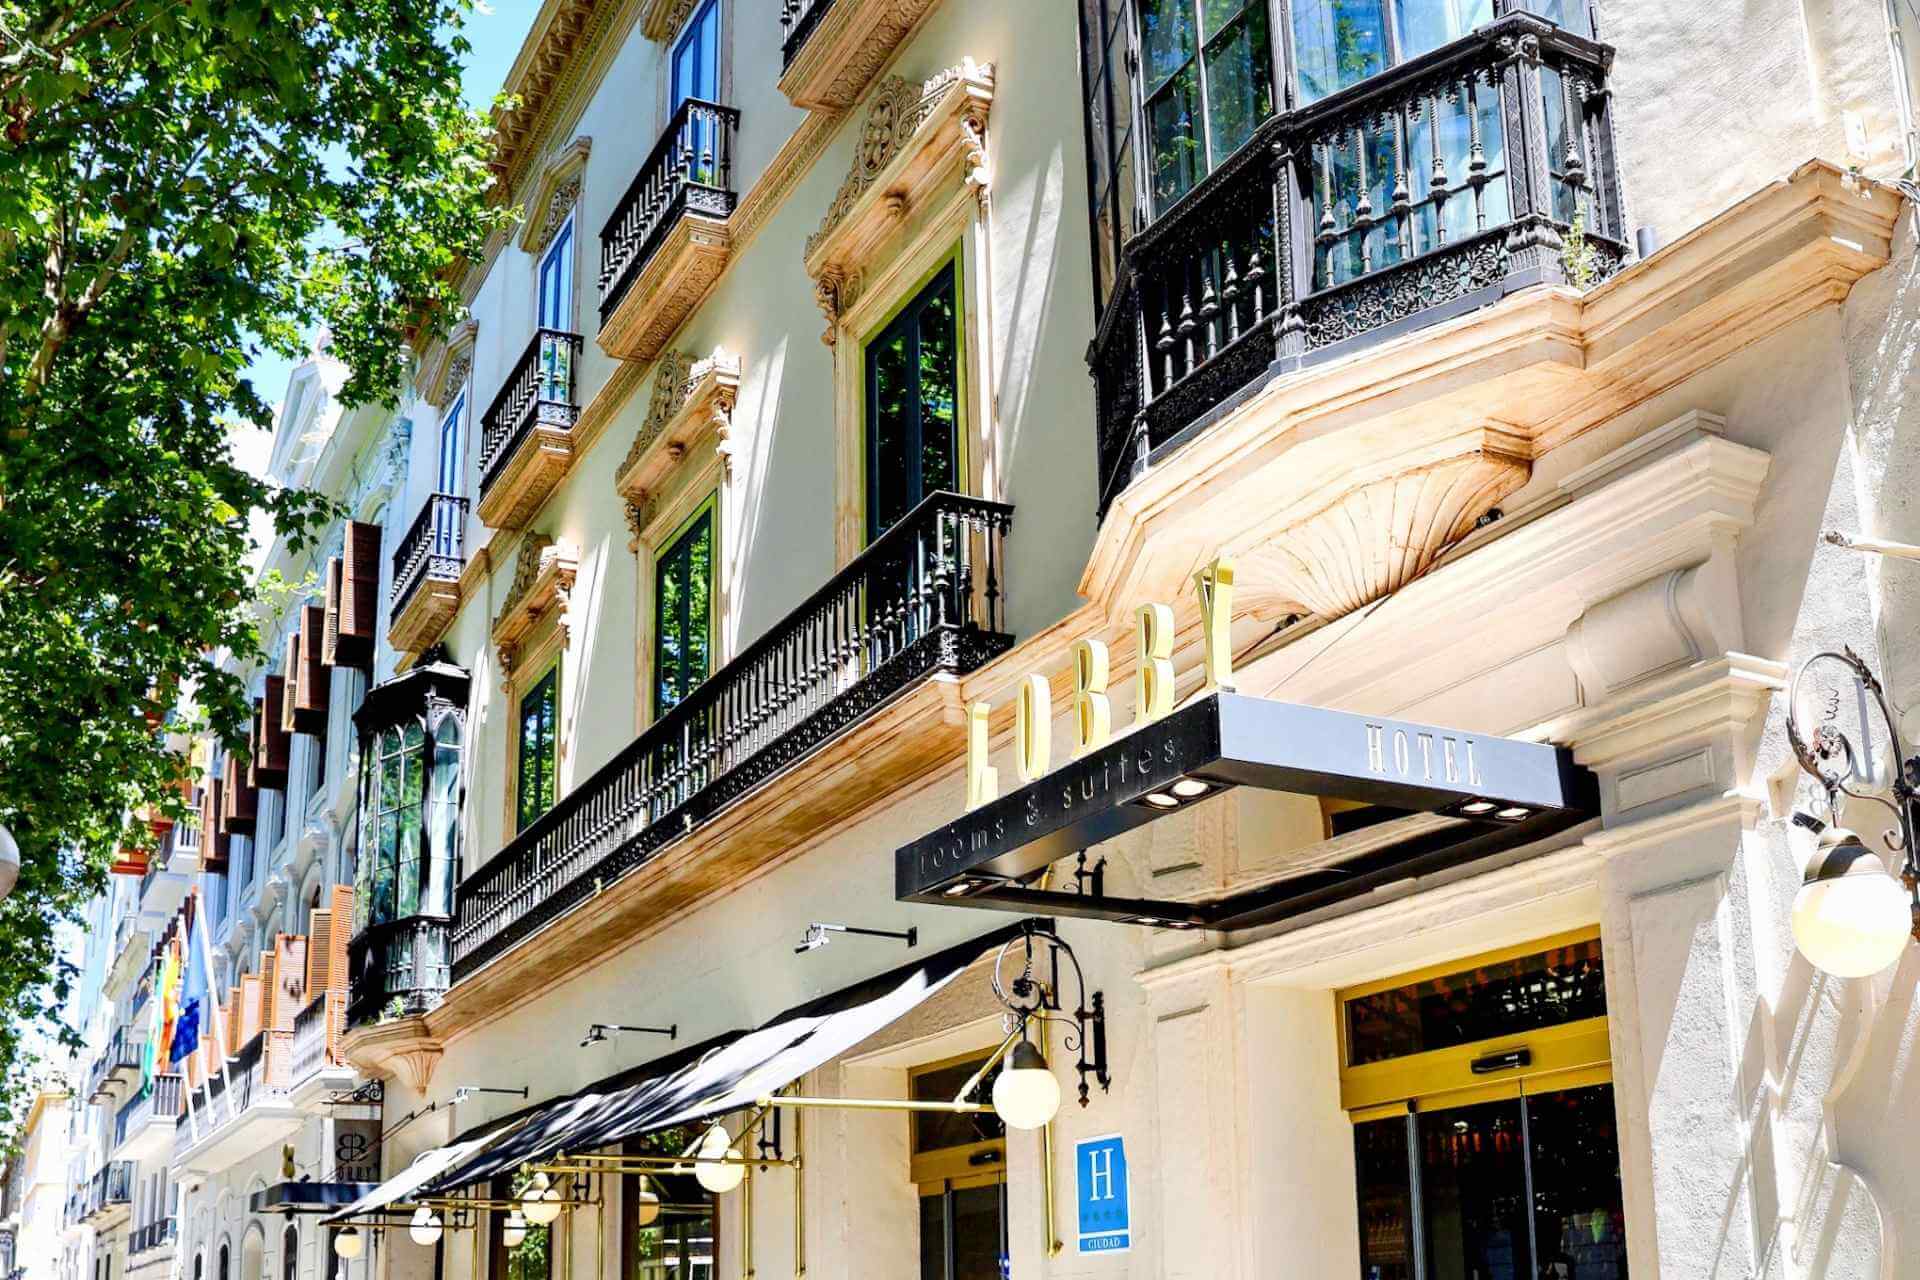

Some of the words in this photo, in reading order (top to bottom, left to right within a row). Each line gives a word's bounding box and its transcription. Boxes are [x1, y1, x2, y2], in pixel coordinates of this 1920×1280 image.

[964, 555, 1234, 813] LOBBY
[1365, 723, 1481, 785] HOTEL
[920, 820, 1004, 874] rooms
[1063, 738, 1176, 809] suites
[1089, 1147, 1115, 1201] H
[1088, 1237, 1120, 1249] CIUDAD
